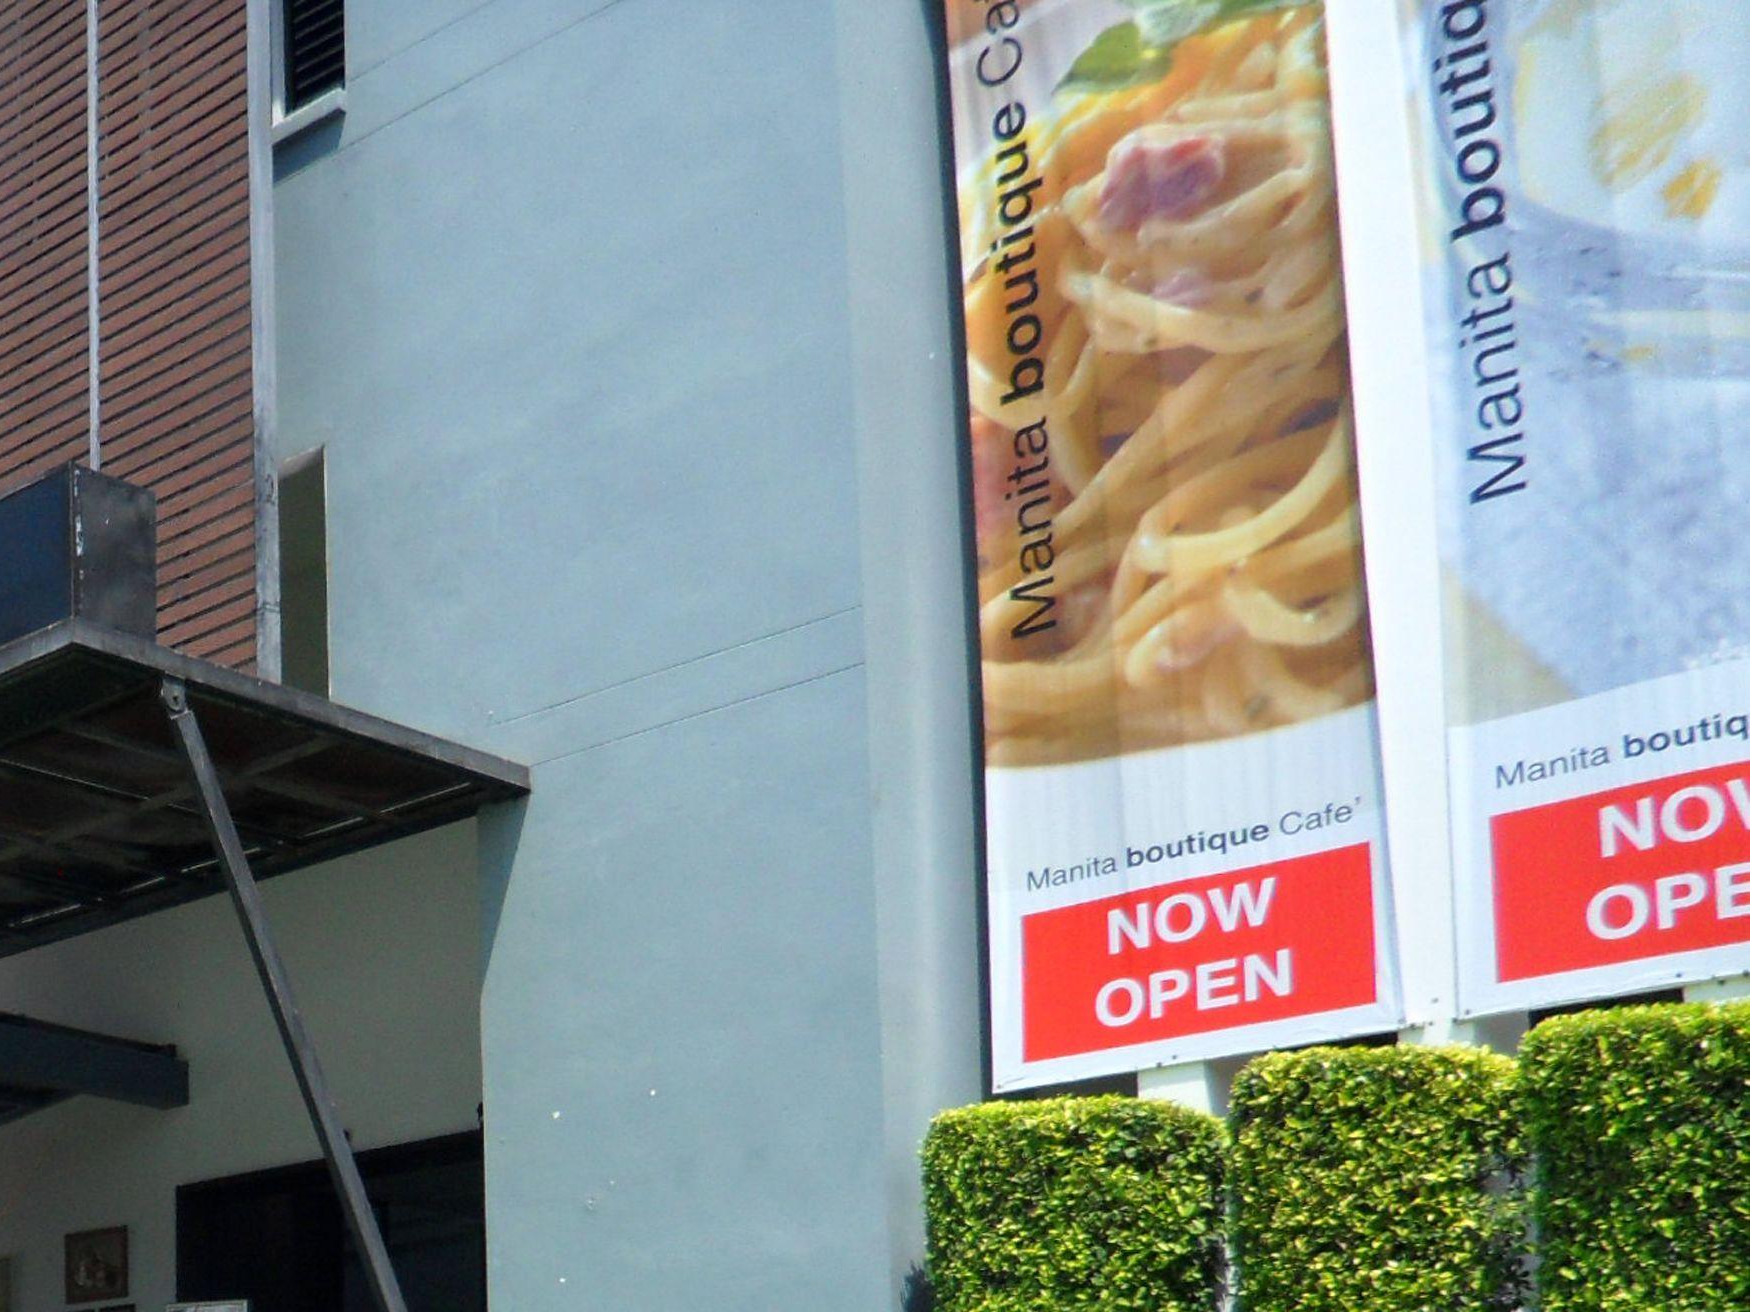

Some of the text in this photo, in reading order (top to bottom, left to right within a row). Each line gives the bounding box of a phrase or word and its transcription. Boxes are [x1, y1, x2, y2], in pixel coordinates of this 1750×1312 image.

[988, 101, 1047, 406] boutique
[1459, 251, 1527, 507] Manita
[1004, 415, 1058, 640] Manita
[1495, 745, 1611, 789] Manita
[1026, 856, 1118, 892] Manita
[1126, 823, 1270, 869] boutique
[1107, 876, 1277, 956] NOW
[1094, 947, 1295, 1029] OPEN
